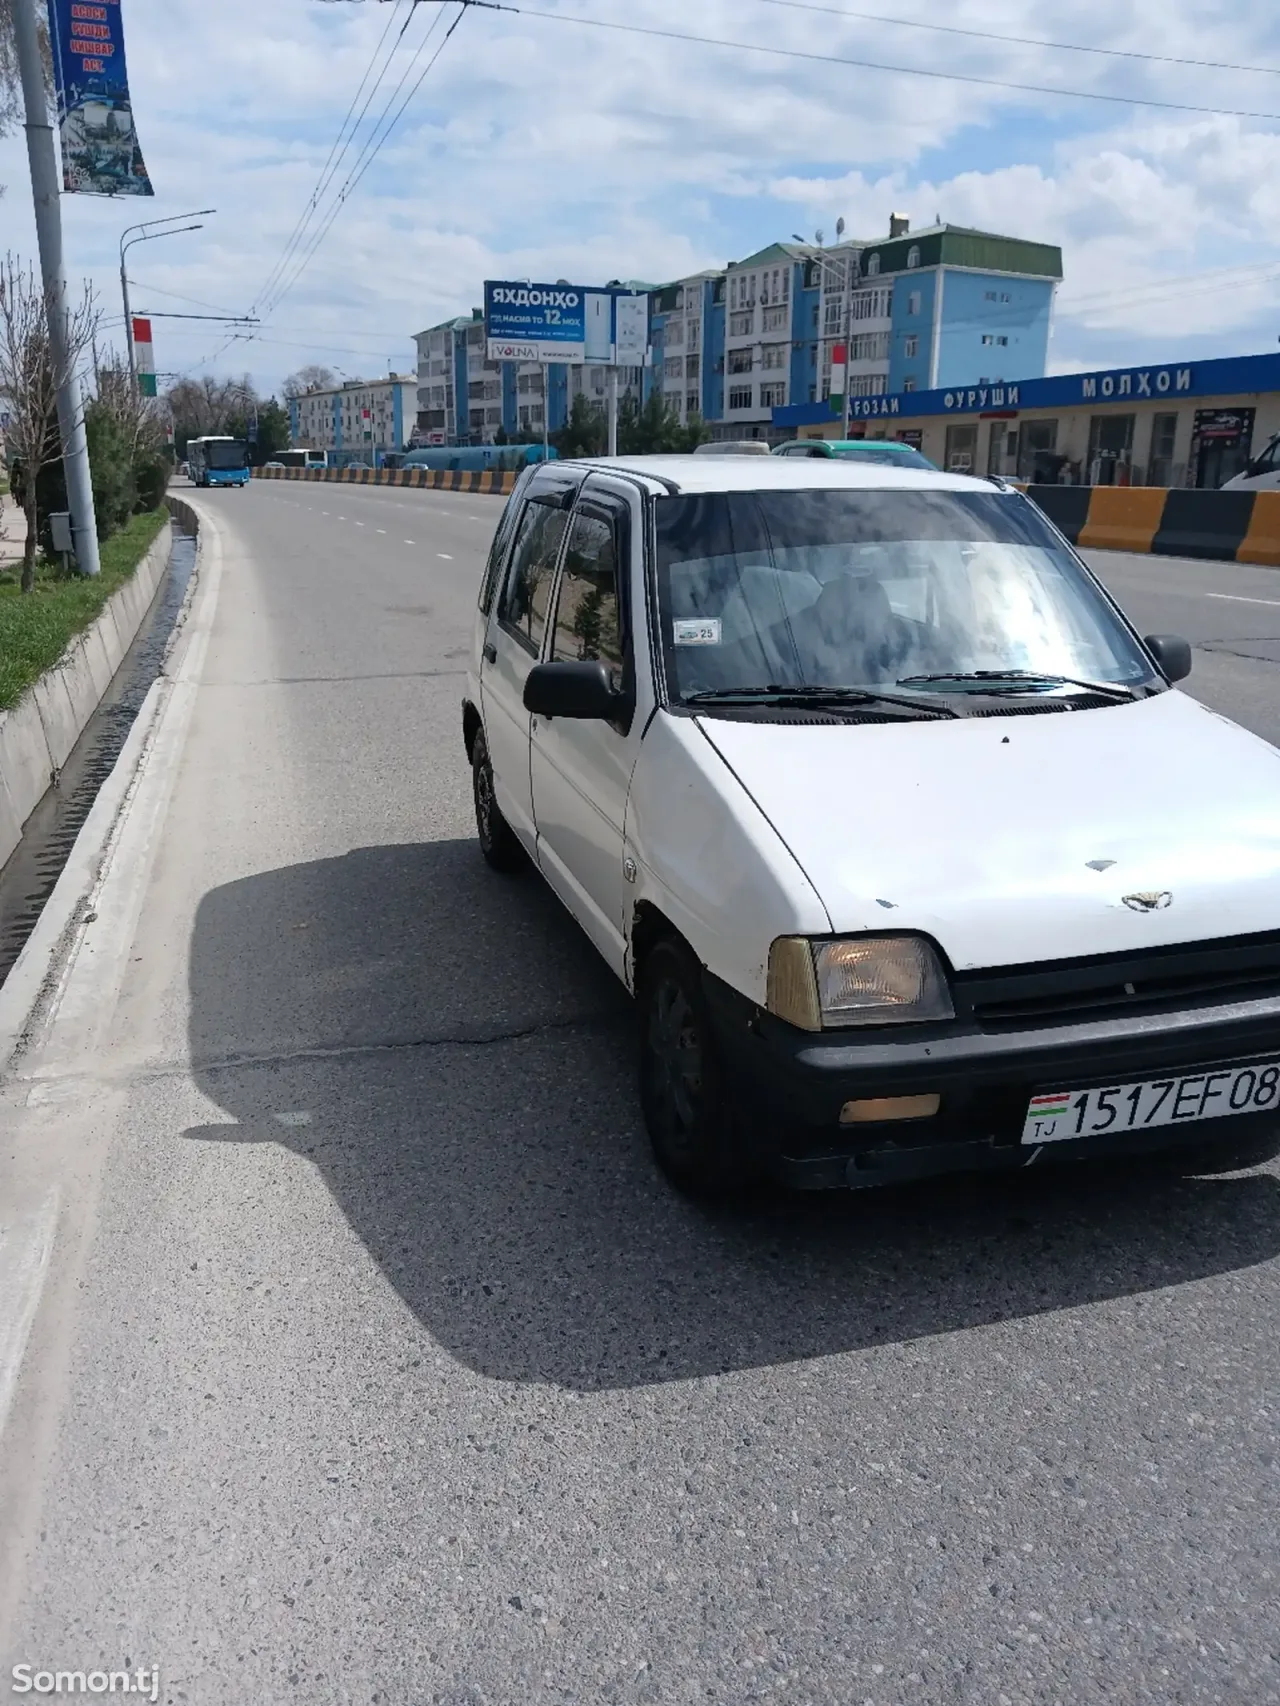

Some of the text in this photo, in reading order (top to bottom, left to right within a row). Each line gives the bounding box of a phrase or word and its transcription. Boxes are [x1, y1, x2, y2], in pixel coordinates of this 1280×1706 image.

[492, 287, 579, 309] ЯХДОНҲО
[544, 308, 561, 325] 12
[943, 385, 1021, 410] ФУРУШИ
[1081, 367, 1192, 398] МОЛҲОИ
[700, 628, 713, 639] 25
[1072, 1066, 1280, 1134] 1517EF08
[1034, 1119, 1057, 1138] TJ
